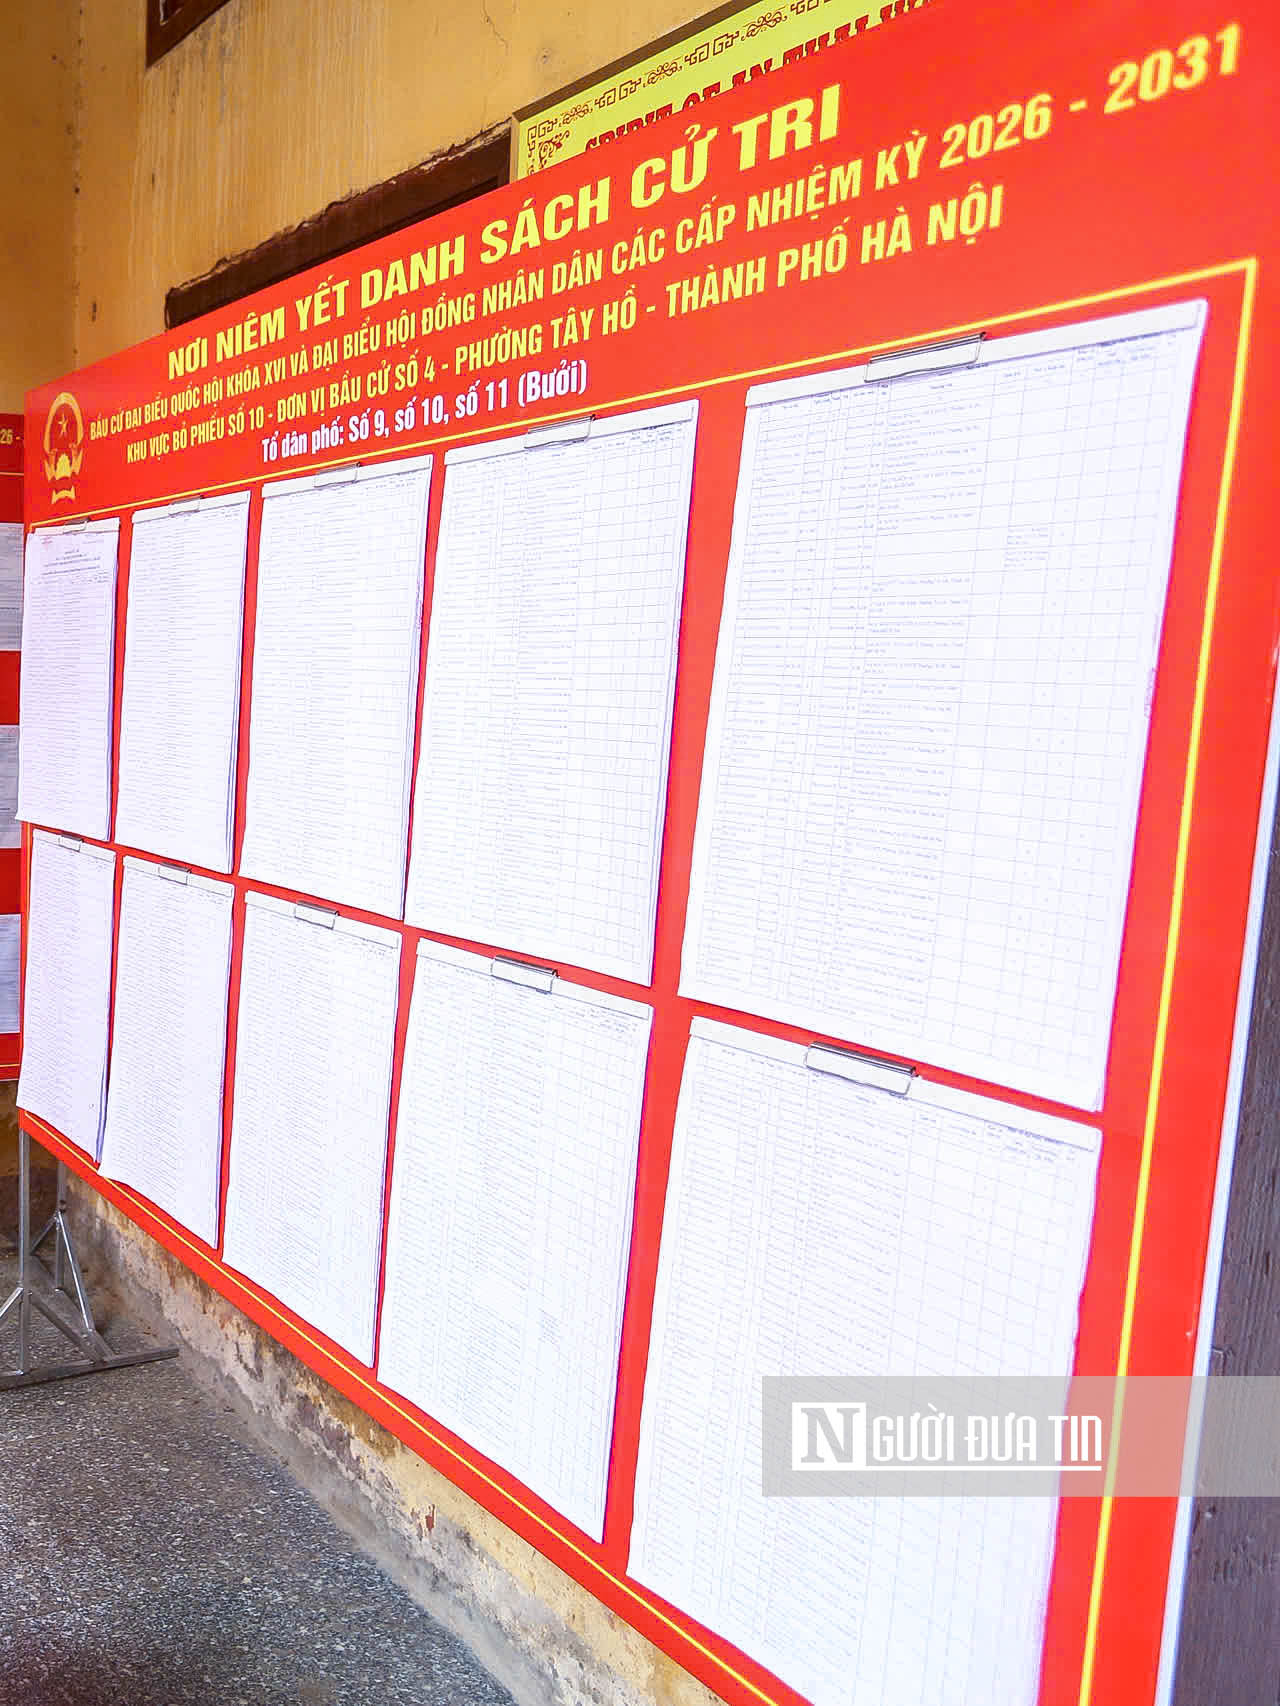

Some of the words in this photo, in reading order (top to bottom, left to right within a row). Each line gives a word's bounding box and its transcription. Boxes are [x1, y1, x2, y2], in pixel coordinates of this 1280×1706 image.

[90, 416, 108, 440] BẦU
[110, 408, 124, 434] CỬ
[125, 407, 141, 429] ĐẠI
[144, 392, 168, 424] BIỂU
[171, 382, 200, 416] QUỐC
[203, 376, 222, 407] HỘI
[226, 365, 260, 397] KHÓA
[264, 357, 286, 385] XVI
[290, 344, 308, 376] VÀ
[312, 338, 337, 371] ĐẠI
[343, 316, 380, 359] BIỂU
[386, 309, 415, 347] HỘI
[421, 292, 475, 335] ĐỒNG
[482, 268, 544, 316] NHÂN
[552, 248, 602, 294] DÂN
[611, 227, 665, 274] CÁC
[675, 195, 736, 253] CẤP
[746, 159, 862, 232] NHIỆM
[874, 130, 927, 189] KỲ
[940, 93, 1052, 168] 2026
[1104, 22, 1240, 114] 2031
[127, 440, 146, 462] KHU
[149, 432, 170, 460] VỰC
[172, 421, 187, 451] BỎ
[190, 412, 224, 445] PHIẾU
[228, 403, 245, 436] SỐ
[249, 406, 264, 430] 10
[277, 392, 306, 422] ĐƠN
[310, 387, 325, 416] VỊ
[330, 370, 360, 408] BẦU
[366, 359, 390, 397] CỬ
[394, 349, 420, 390] SỐ
[424, 356, 435, 381] 4
[455, 324, 543, 374] PHƯỜNG
[550, 307, 594, 348] TÂY
[602, 284, 637, 335] HỒ
[666, 256, 766, 317] THÀNH
[777, 217, 850, 287] PHỐ
[860, 206, 912, 264] HÀ
[926, 182, 1004, 245] NỘI
[168, 337, 207, 380] NƠI
[216, 306, 284, 362] NIÊM
[296, 274, 350, 331] YẾT
[361, 234, 464, 308] DANH
[480, 176, 610, 264] SÁCH
[630, 124, 717, 208] CỬ
[732, 84, 840, 171] TRI
[262, 430, 279, 462] Tổ
[281, 431, 307, 458] dân
[311, 416, 344, 454] phố:
[348, 408, 370, 442] Số
[374, 410, 390, 437] 9,
[394, 396, 417, 432] số
[421, 395, 449, 425] 10,
[455, 380, 481, 418] số
[485, 378, 507, 410] 11
[518, 359, 586, 407] (Bưởi)
